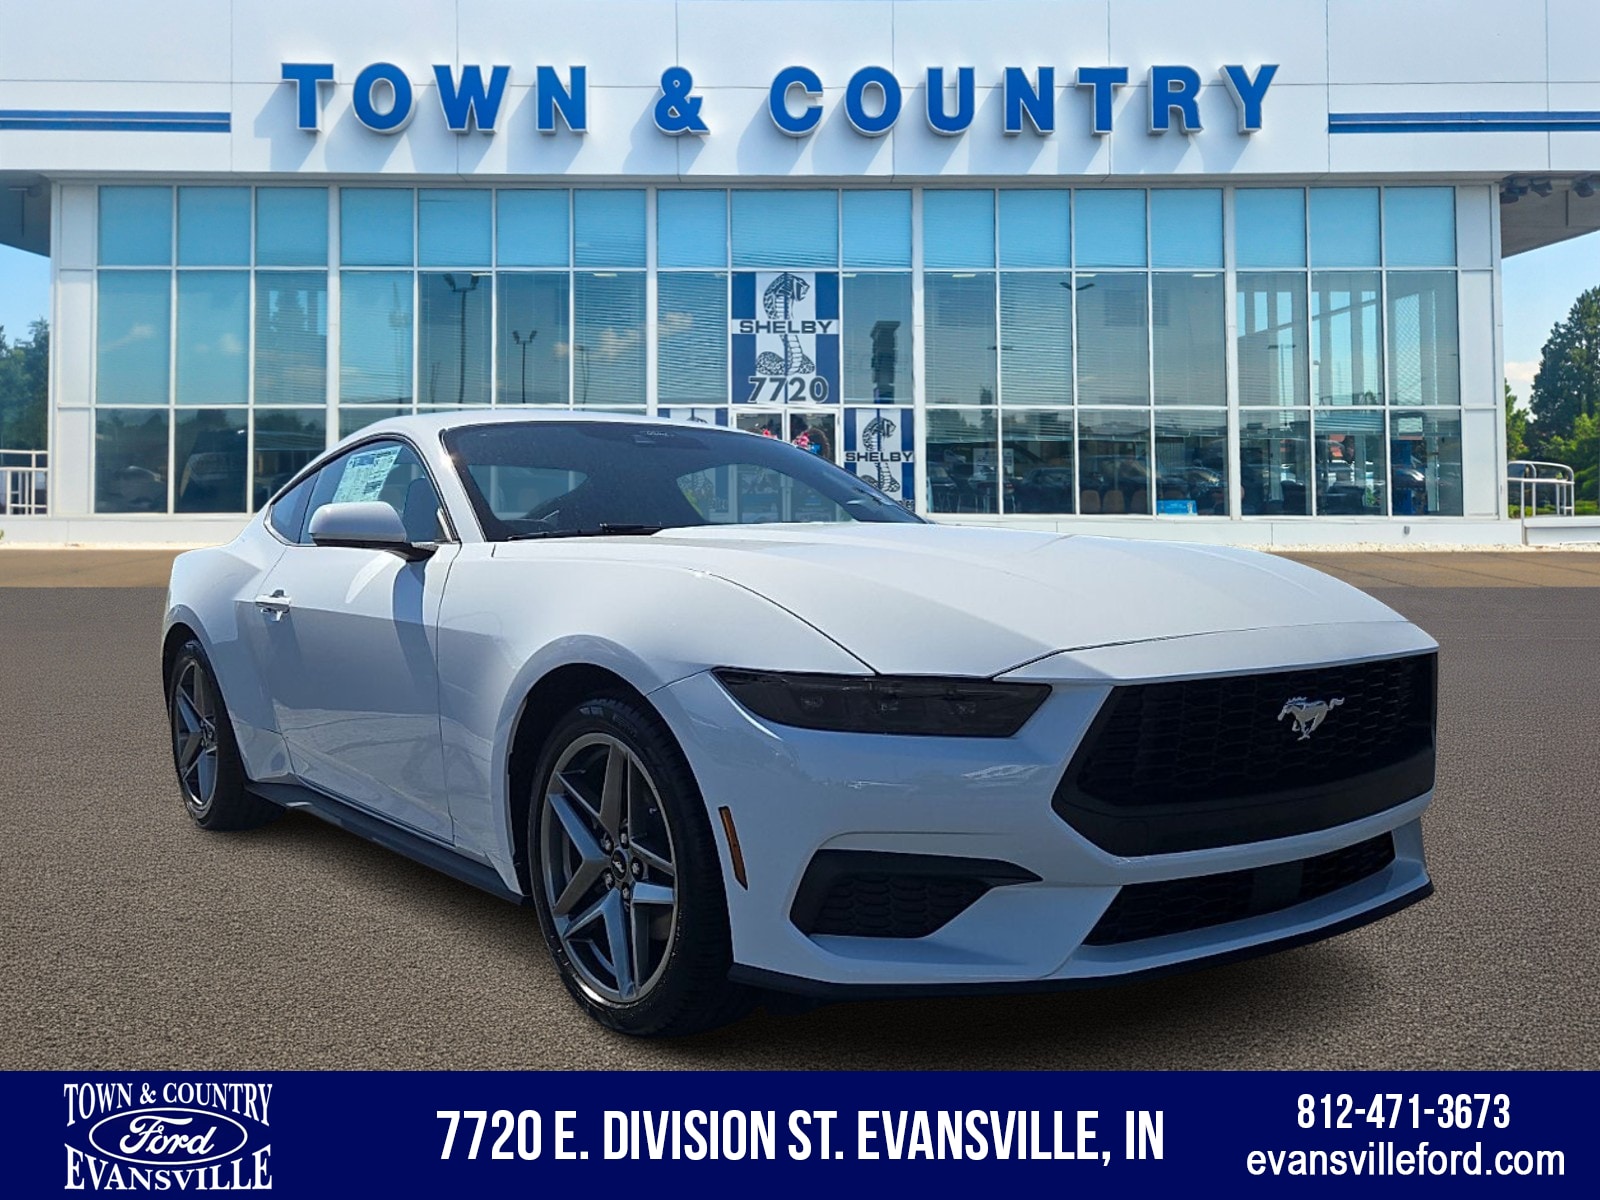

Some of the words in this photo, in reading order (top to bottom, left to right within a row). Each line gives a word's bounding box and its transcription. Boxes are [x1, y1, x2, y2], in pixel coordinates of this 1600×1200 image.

[281, 62, 588, 134] TOWN
[653, 65, 710, 136] &
[768, 63, 1280, 136] COUNTRY
[739, 320, 833, 334] SHELBY
[748, 376, 829, 404] 7720
[845, 451, 913, 462] SHELBY
